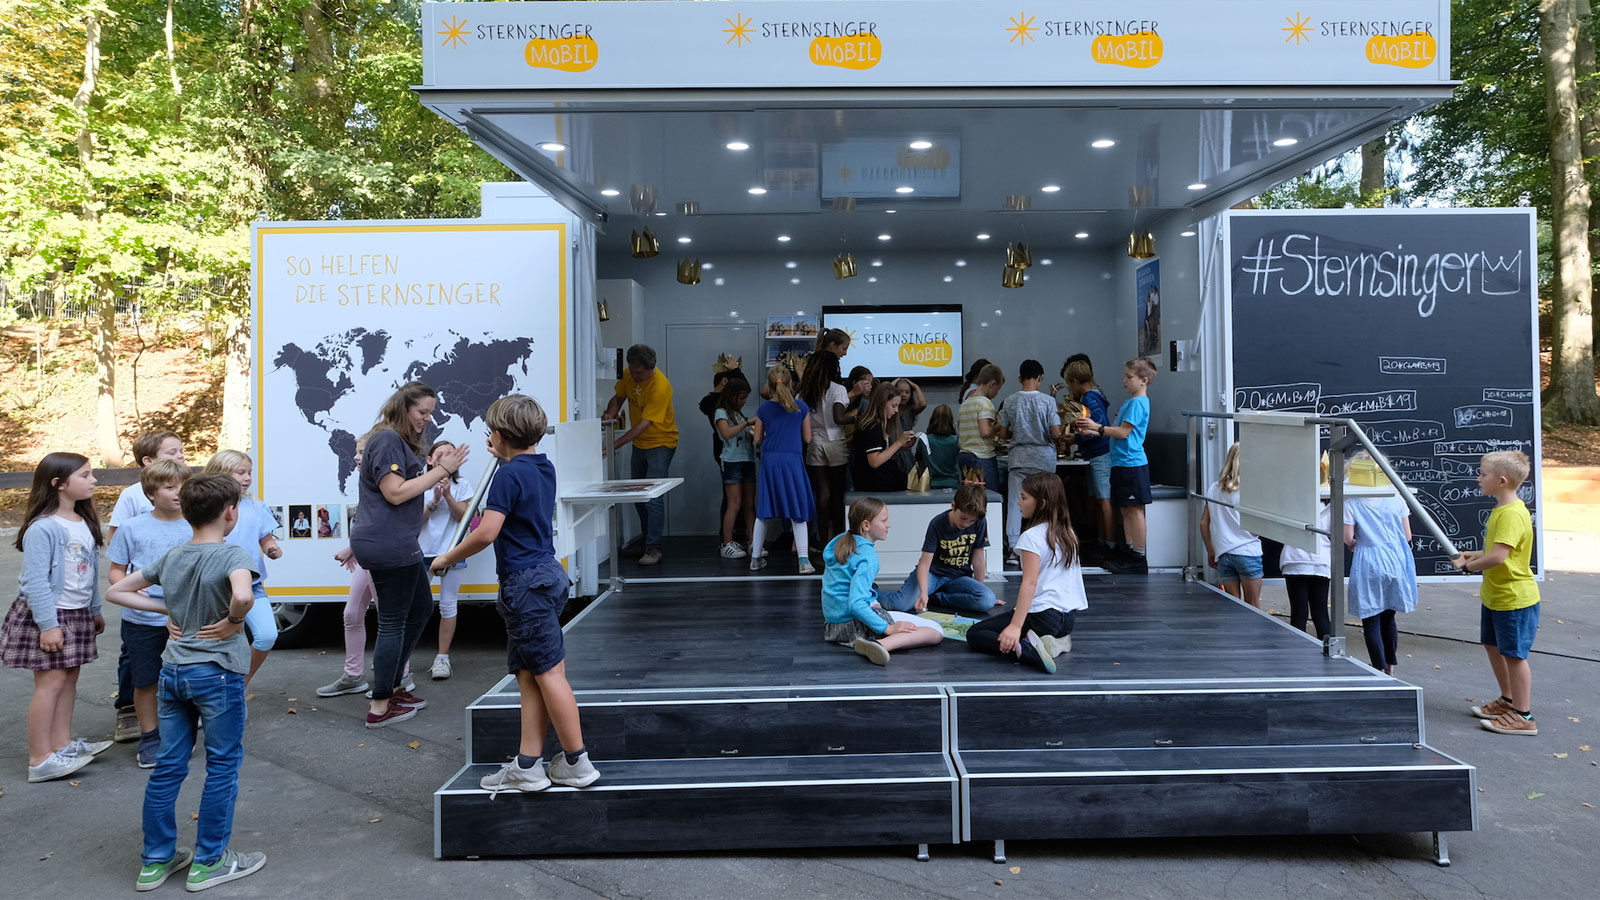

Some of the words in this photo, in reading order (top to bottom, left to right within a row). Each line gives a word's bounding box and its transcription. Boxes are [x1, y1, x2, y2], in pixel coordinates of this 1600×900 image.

[477, 24, 593, 40] STERNSINGER
[762, 22, 877, 38] STERNSINGER
[1045, 21, 1159, 37] STERNSINGER
[1321, 21, 1433, 37] STERNSINGER
[531, 44, 593, 65] MOBIL
[815, 42, 876, 62] MOBIL
[1097, 40, 1158, 61] MOBIL
[1371, 41, 1432, 61] MOBIL
[286, 256, 311, 276] SO
[321, 254, 398, 276] HELFEN
[1242, 234, 1479, 317] #Sternsinger
[296, 284, 328, 303] DIE
[337, 282, 501, 307] STERNSINGER
[863, 332, 949, 345] STERNSINGER
[902, 346, 948, 362] MOBIL
